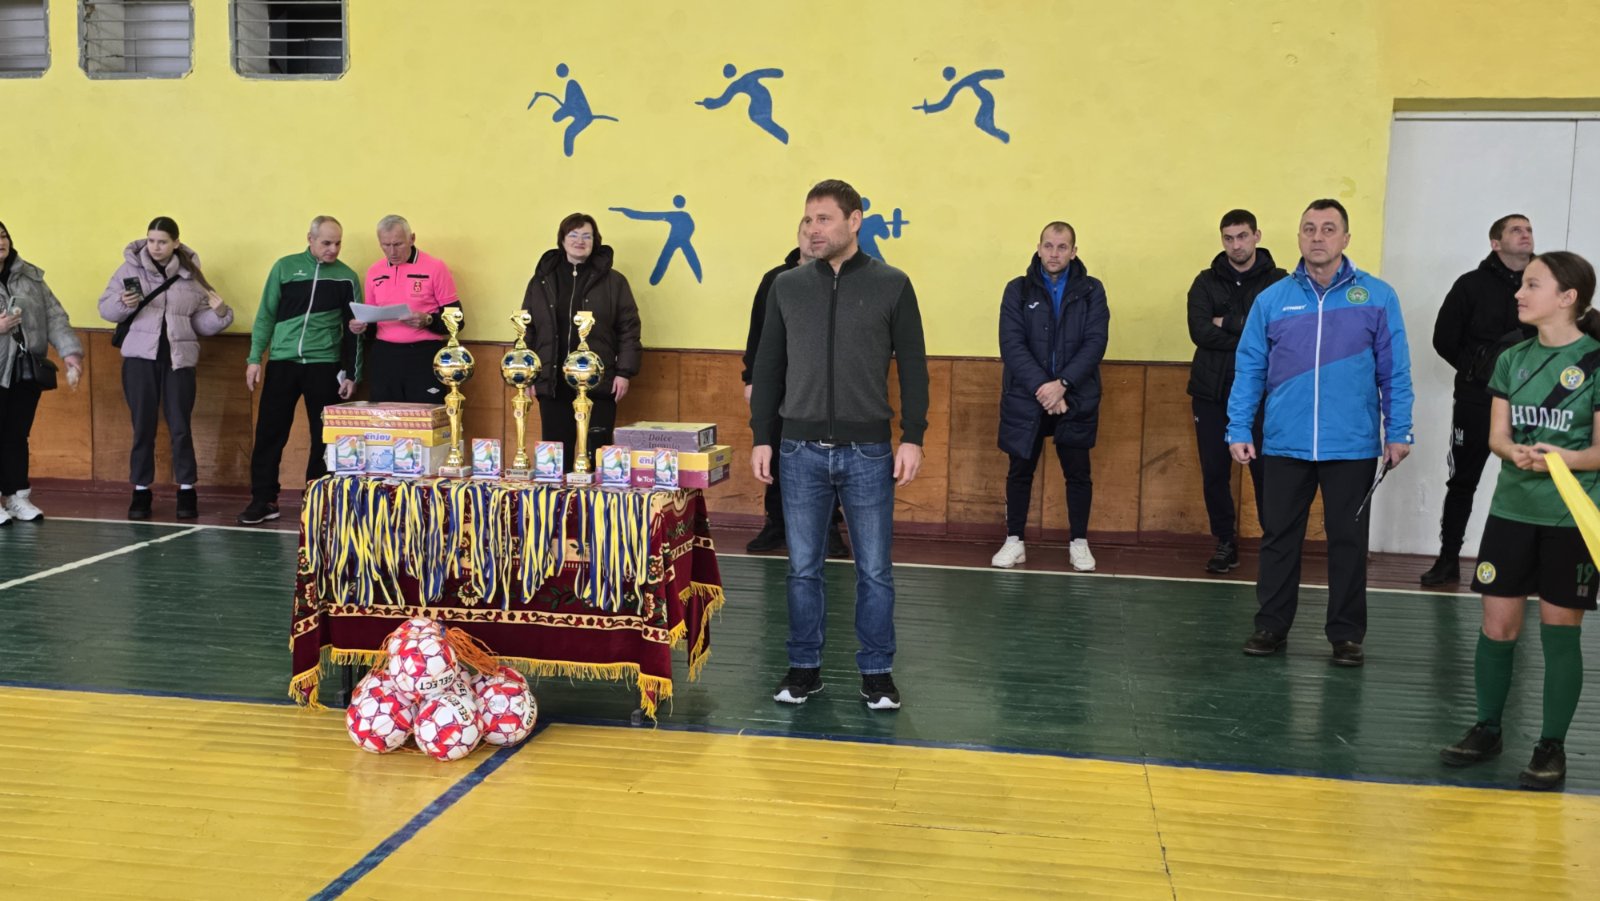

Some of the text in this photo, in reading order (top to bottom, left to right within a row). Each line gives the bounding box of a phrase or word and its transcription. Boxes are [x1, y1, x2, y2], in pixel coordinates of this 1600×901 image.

[365, 432, 390, 441] enjoy
[648, 433, 673, 442] Dolce
[639, 456, 654, 465] enj
[1576, 559, 1594, 584] 19
[419, 673, 454, 691] SELECT
